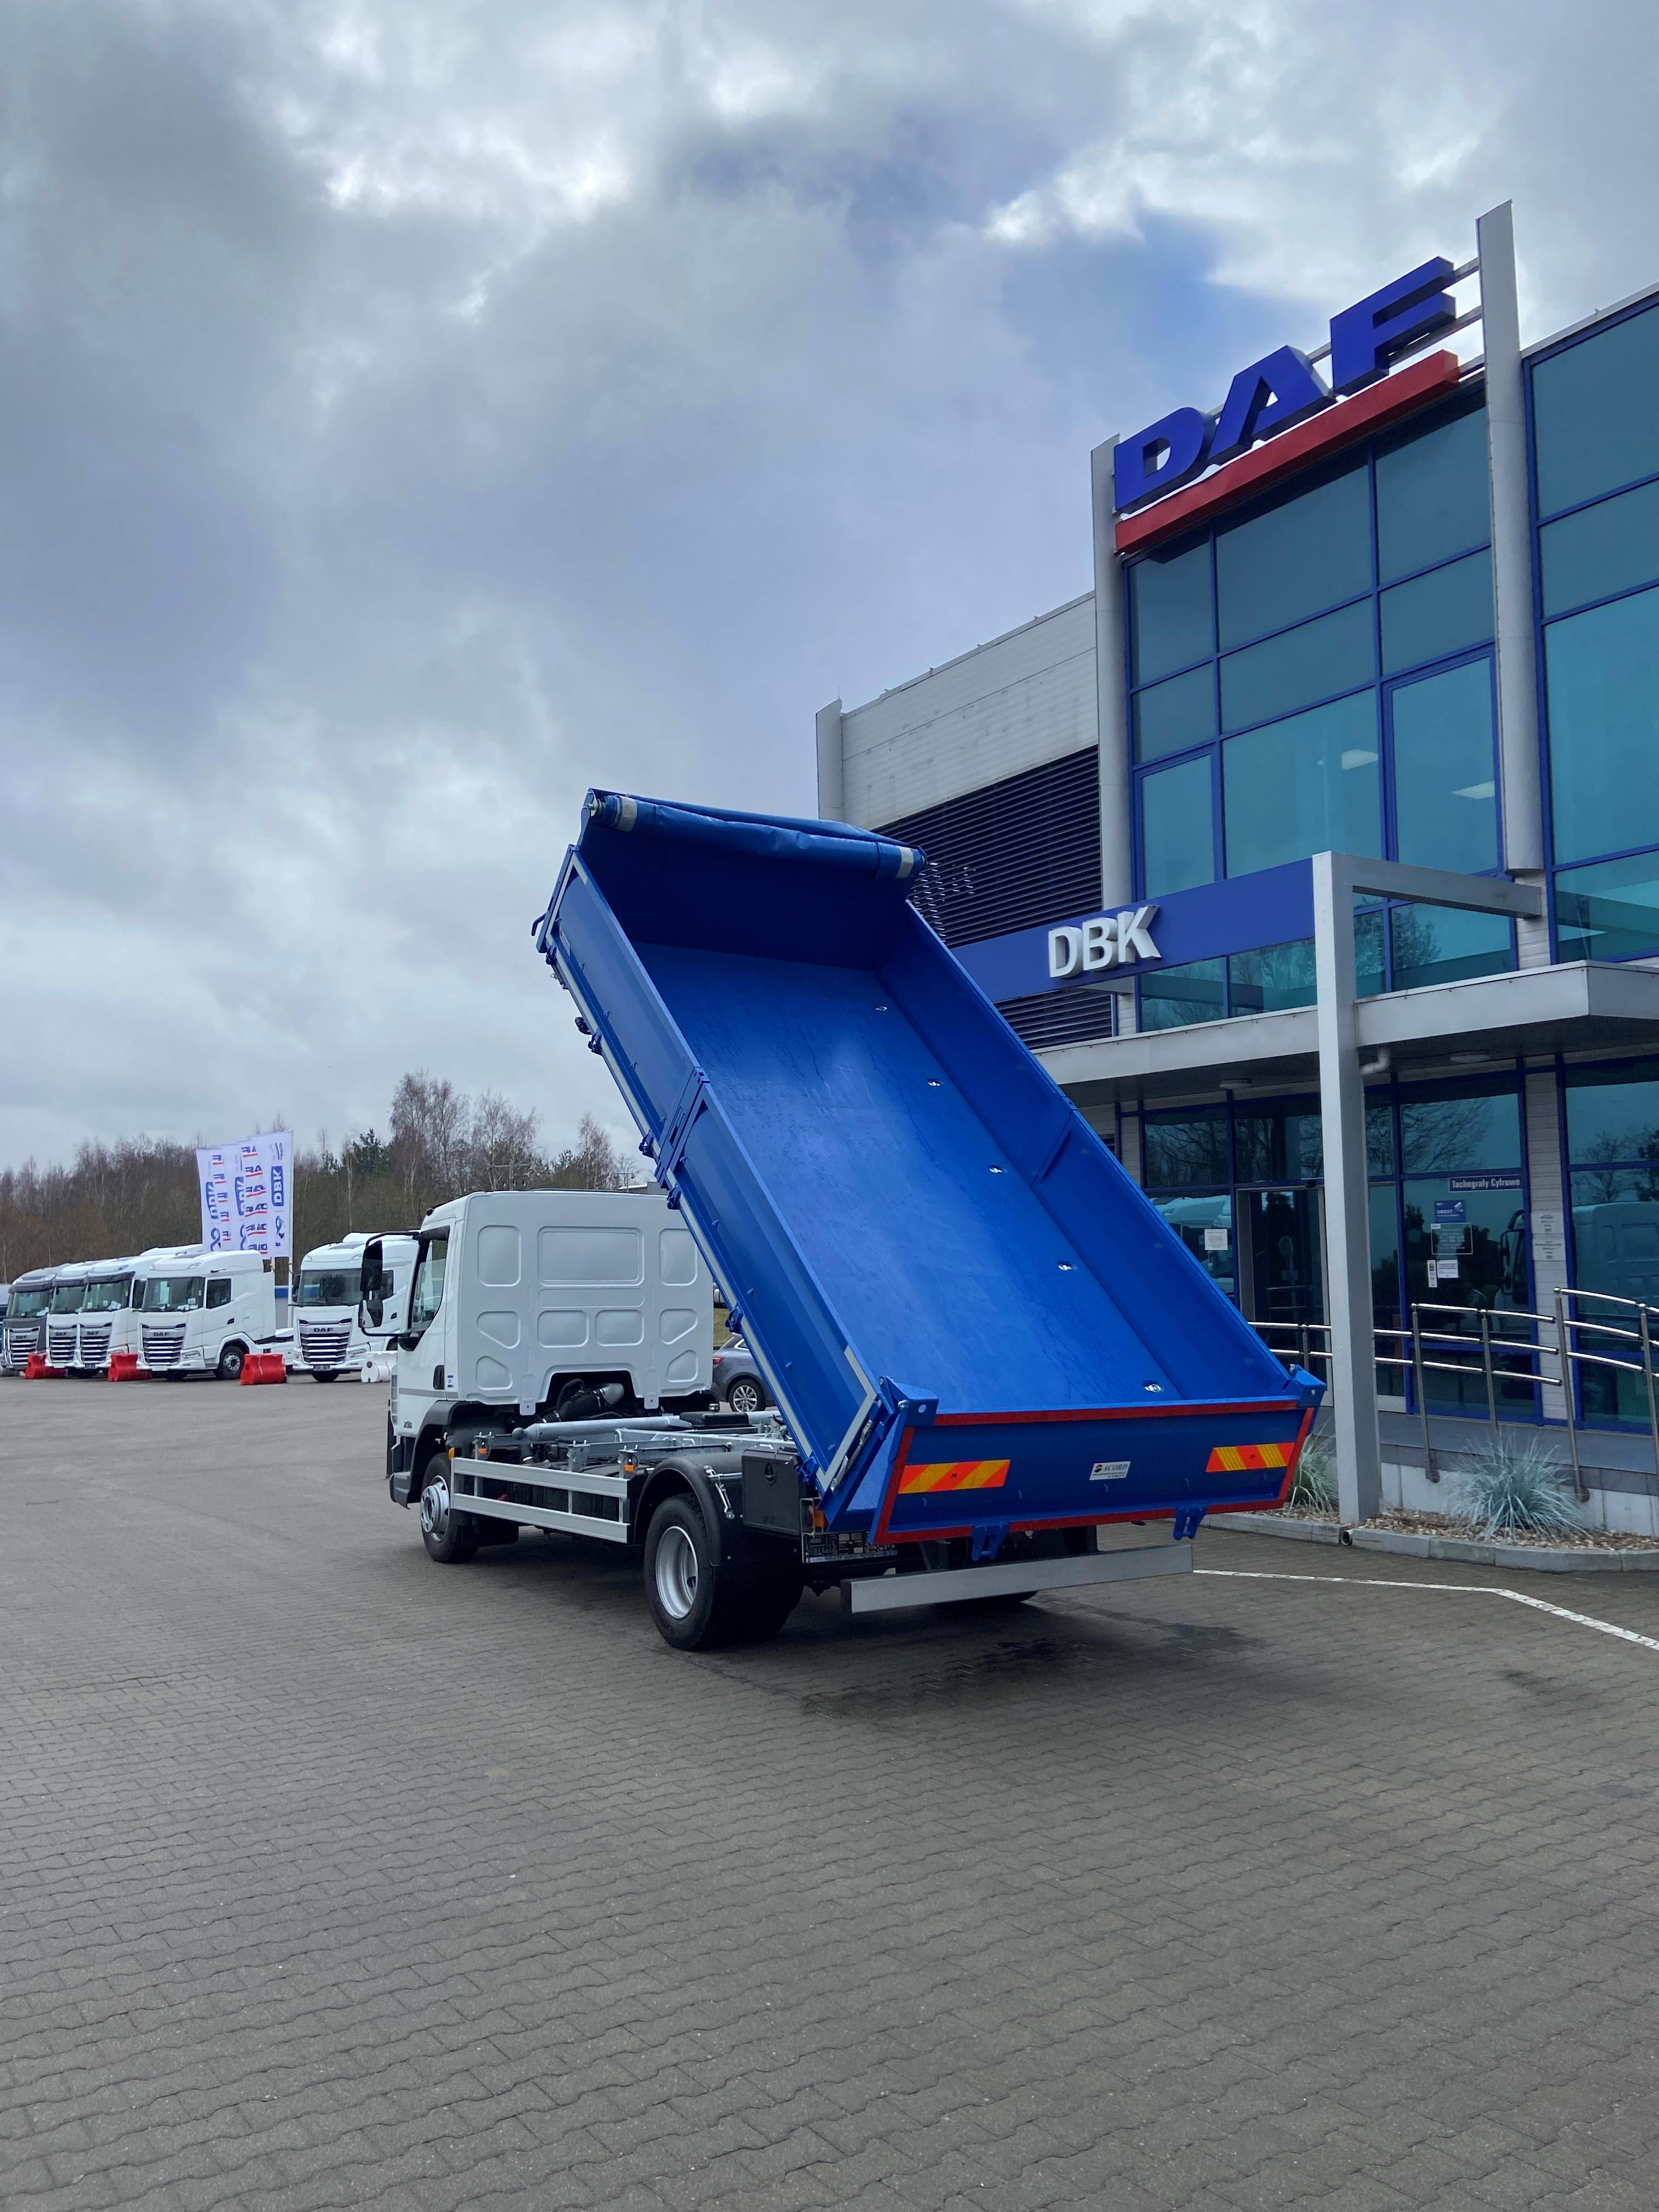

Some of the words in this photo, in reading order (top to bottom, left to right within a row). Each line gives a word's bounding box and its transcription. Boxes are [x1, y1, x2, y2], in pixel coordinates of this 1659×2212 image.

[1114, 256, 1457, 514] DAF
[1048, 905, 1162, 979] DBK
[274, 1169, 283, 1203] DBK
